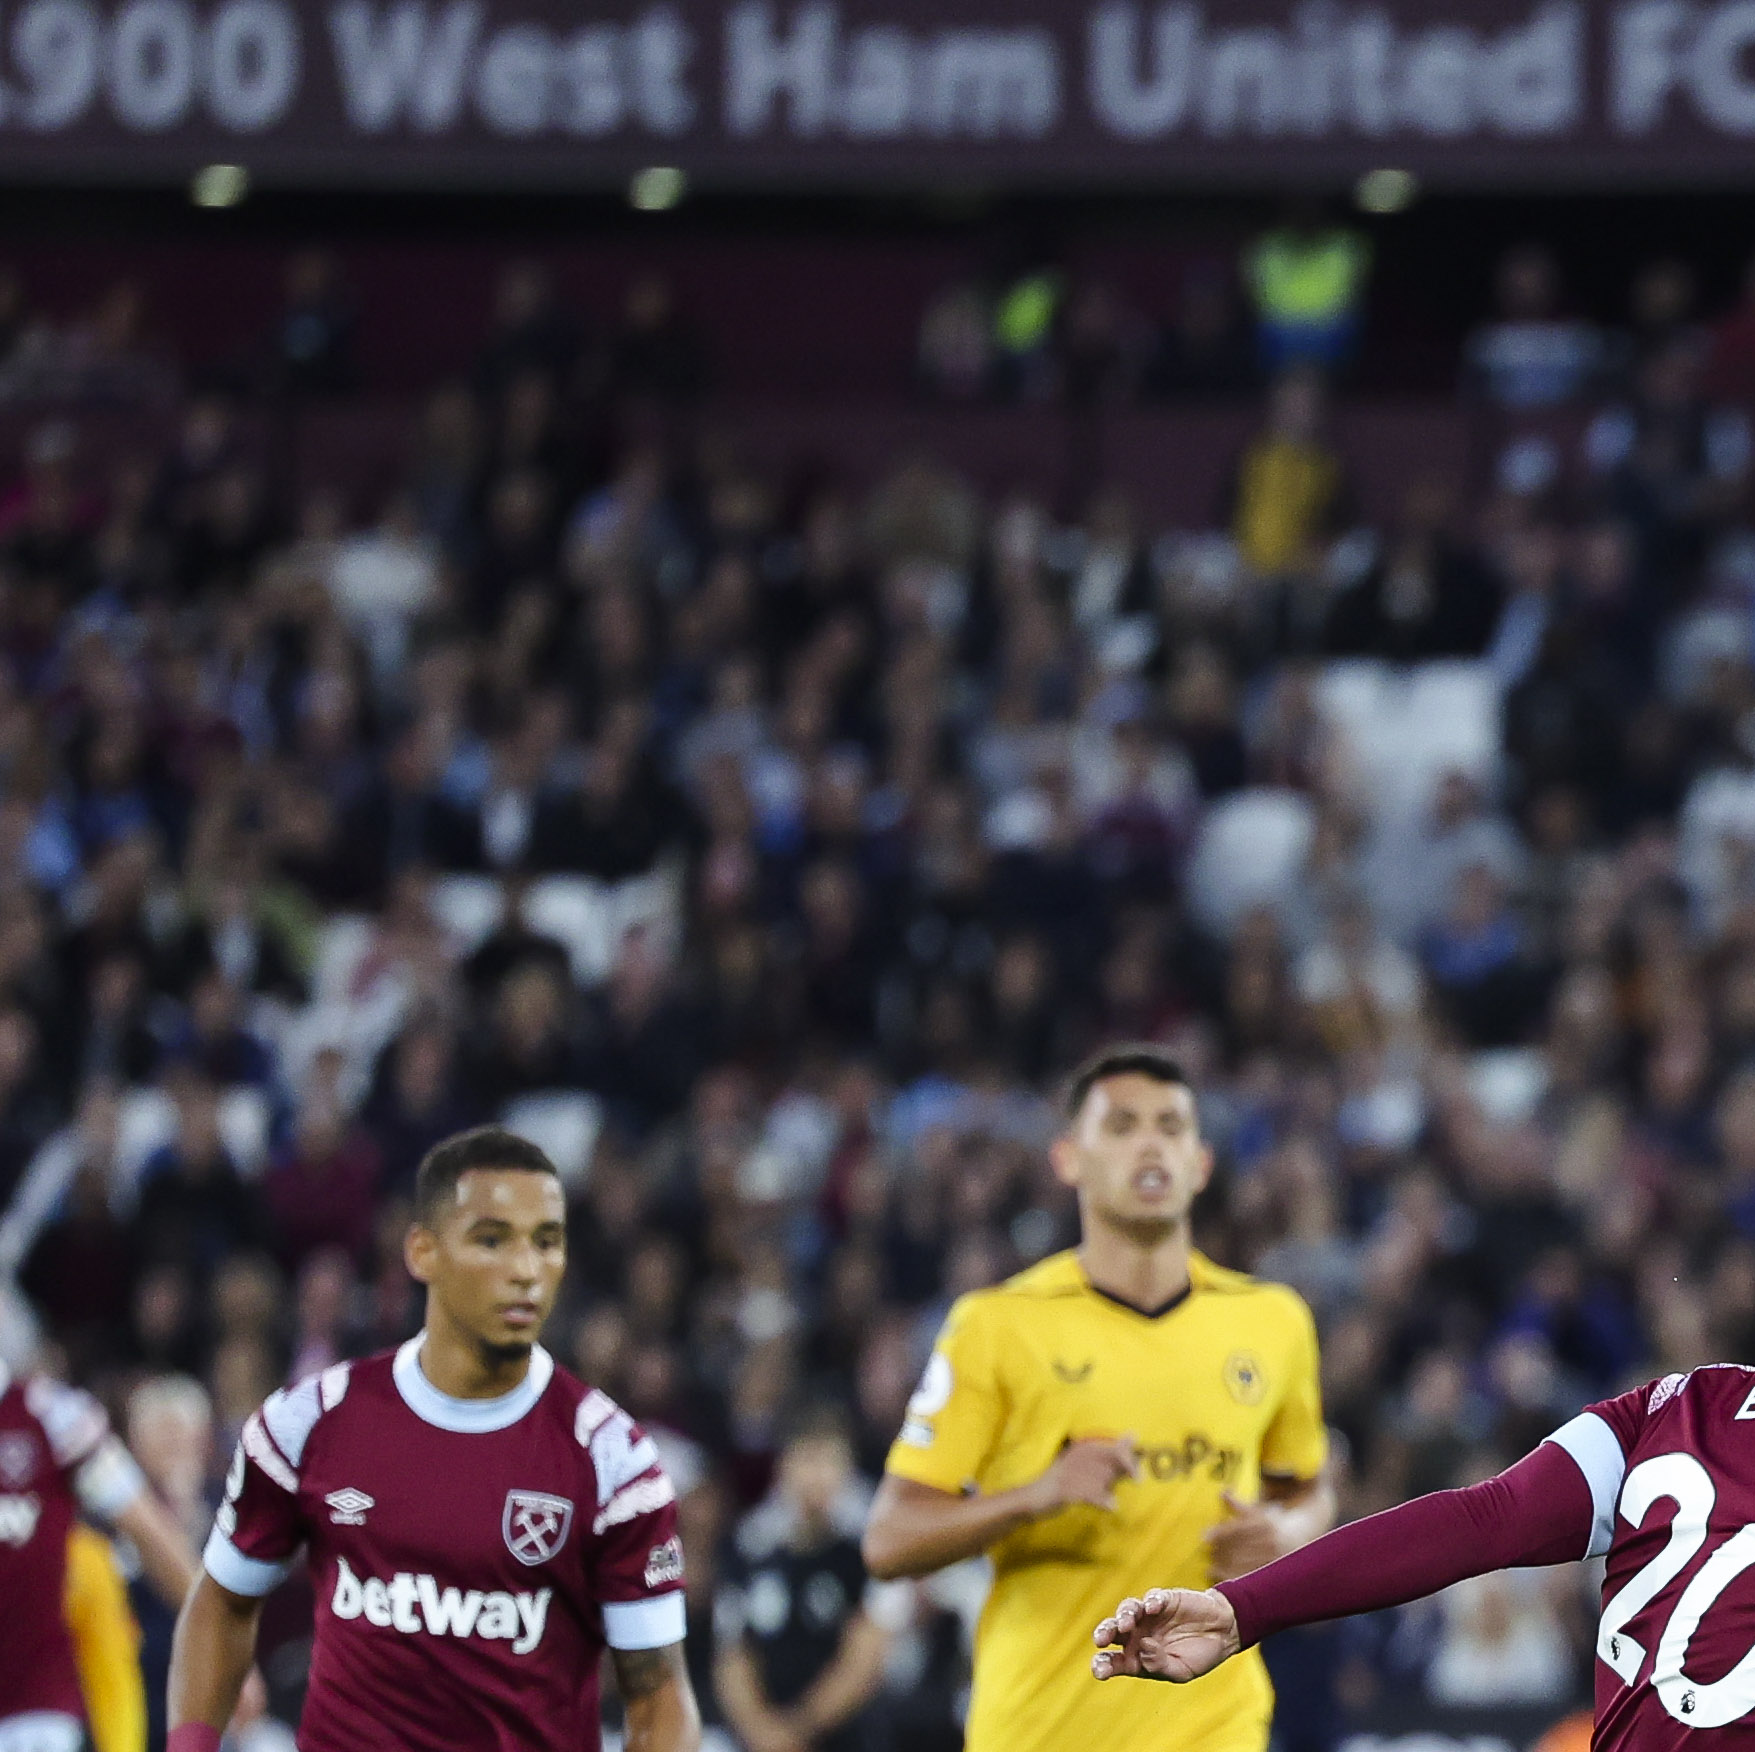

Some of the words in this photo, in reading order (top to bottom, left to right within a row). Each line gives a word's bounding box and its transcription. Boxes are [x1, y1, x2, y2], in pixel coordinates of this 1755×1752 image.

[0, 0, 298, 134] 900
[329, 0, 690, 136] West
[724, 0, 1057, 136] Ham
[1089, 0, 1580, 138] United
[331, 1554, 554, 1655] betway
